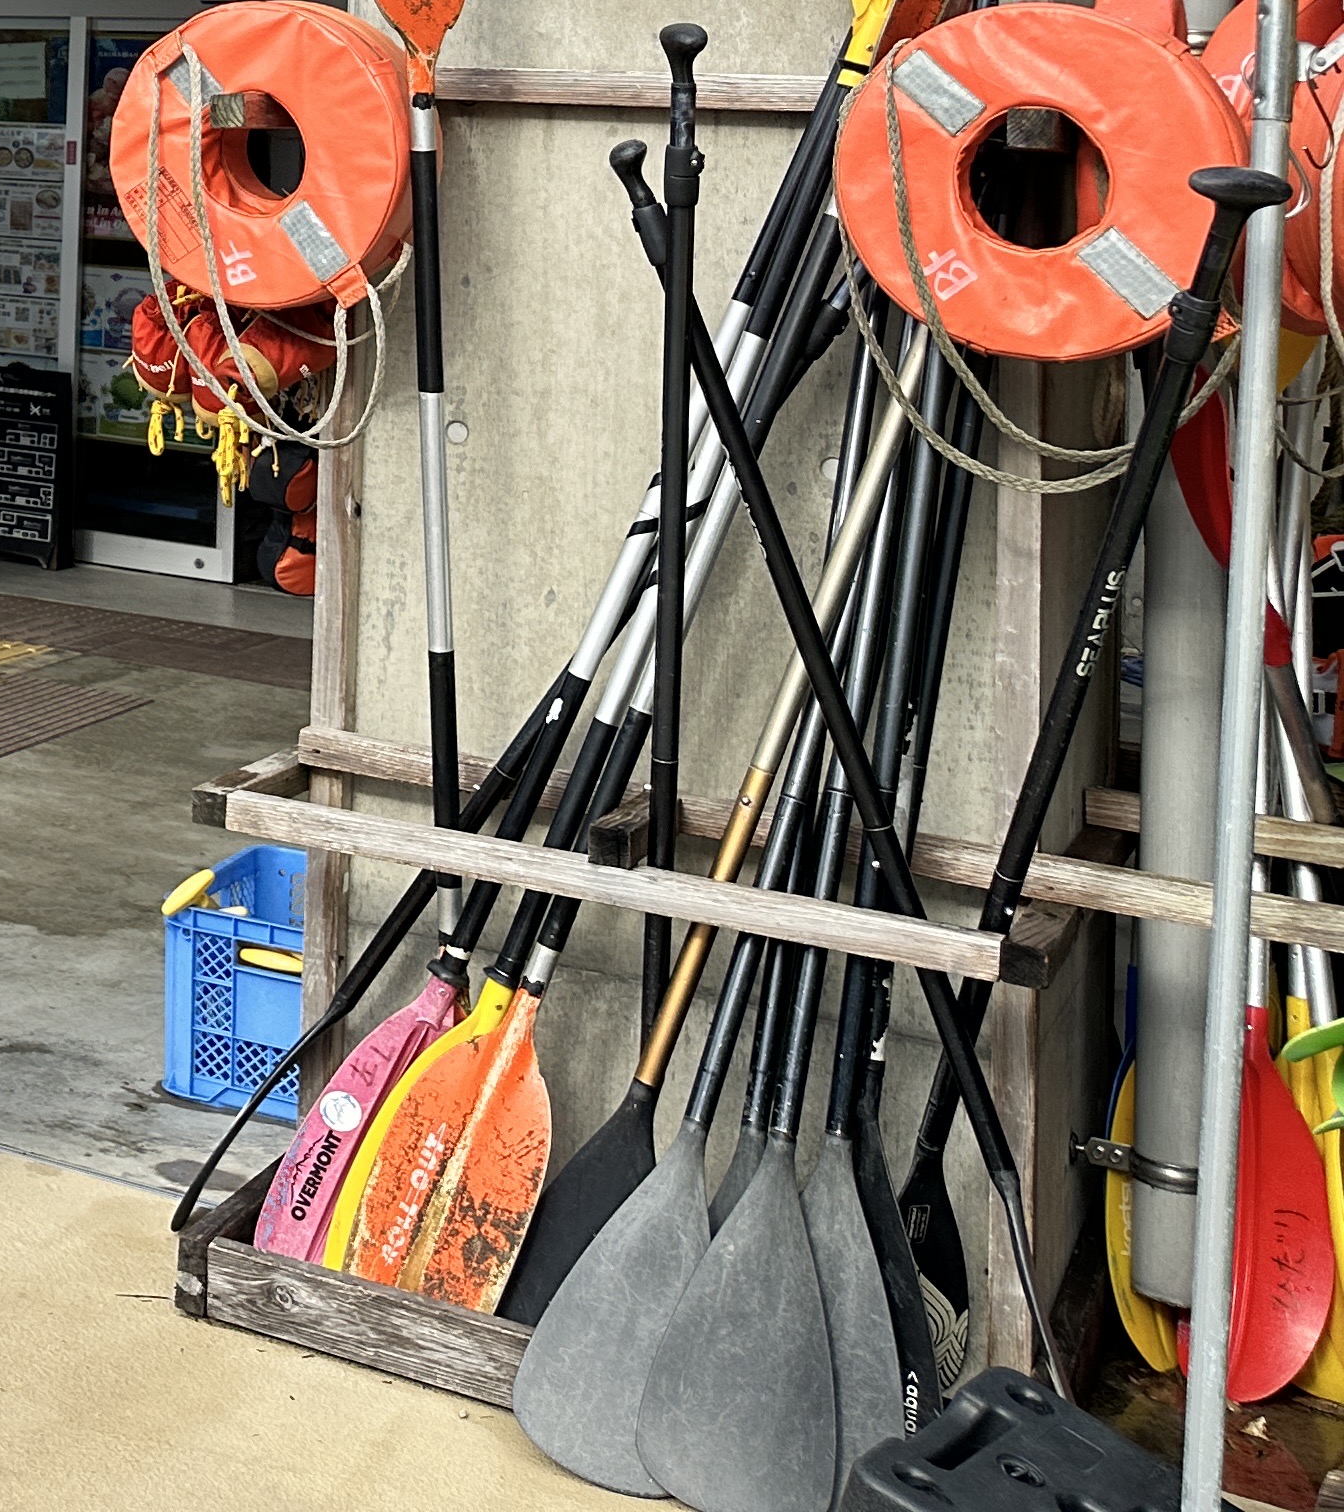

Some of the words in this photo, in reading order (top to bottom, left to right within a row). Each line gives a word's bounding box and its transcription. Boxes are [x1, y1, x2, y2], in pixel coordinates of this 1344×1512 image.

[219, 239, 257, 286] BF
[290, 1129, 342, 1222] OVERMONT
[903, 1384, 919, 1436] aqua
